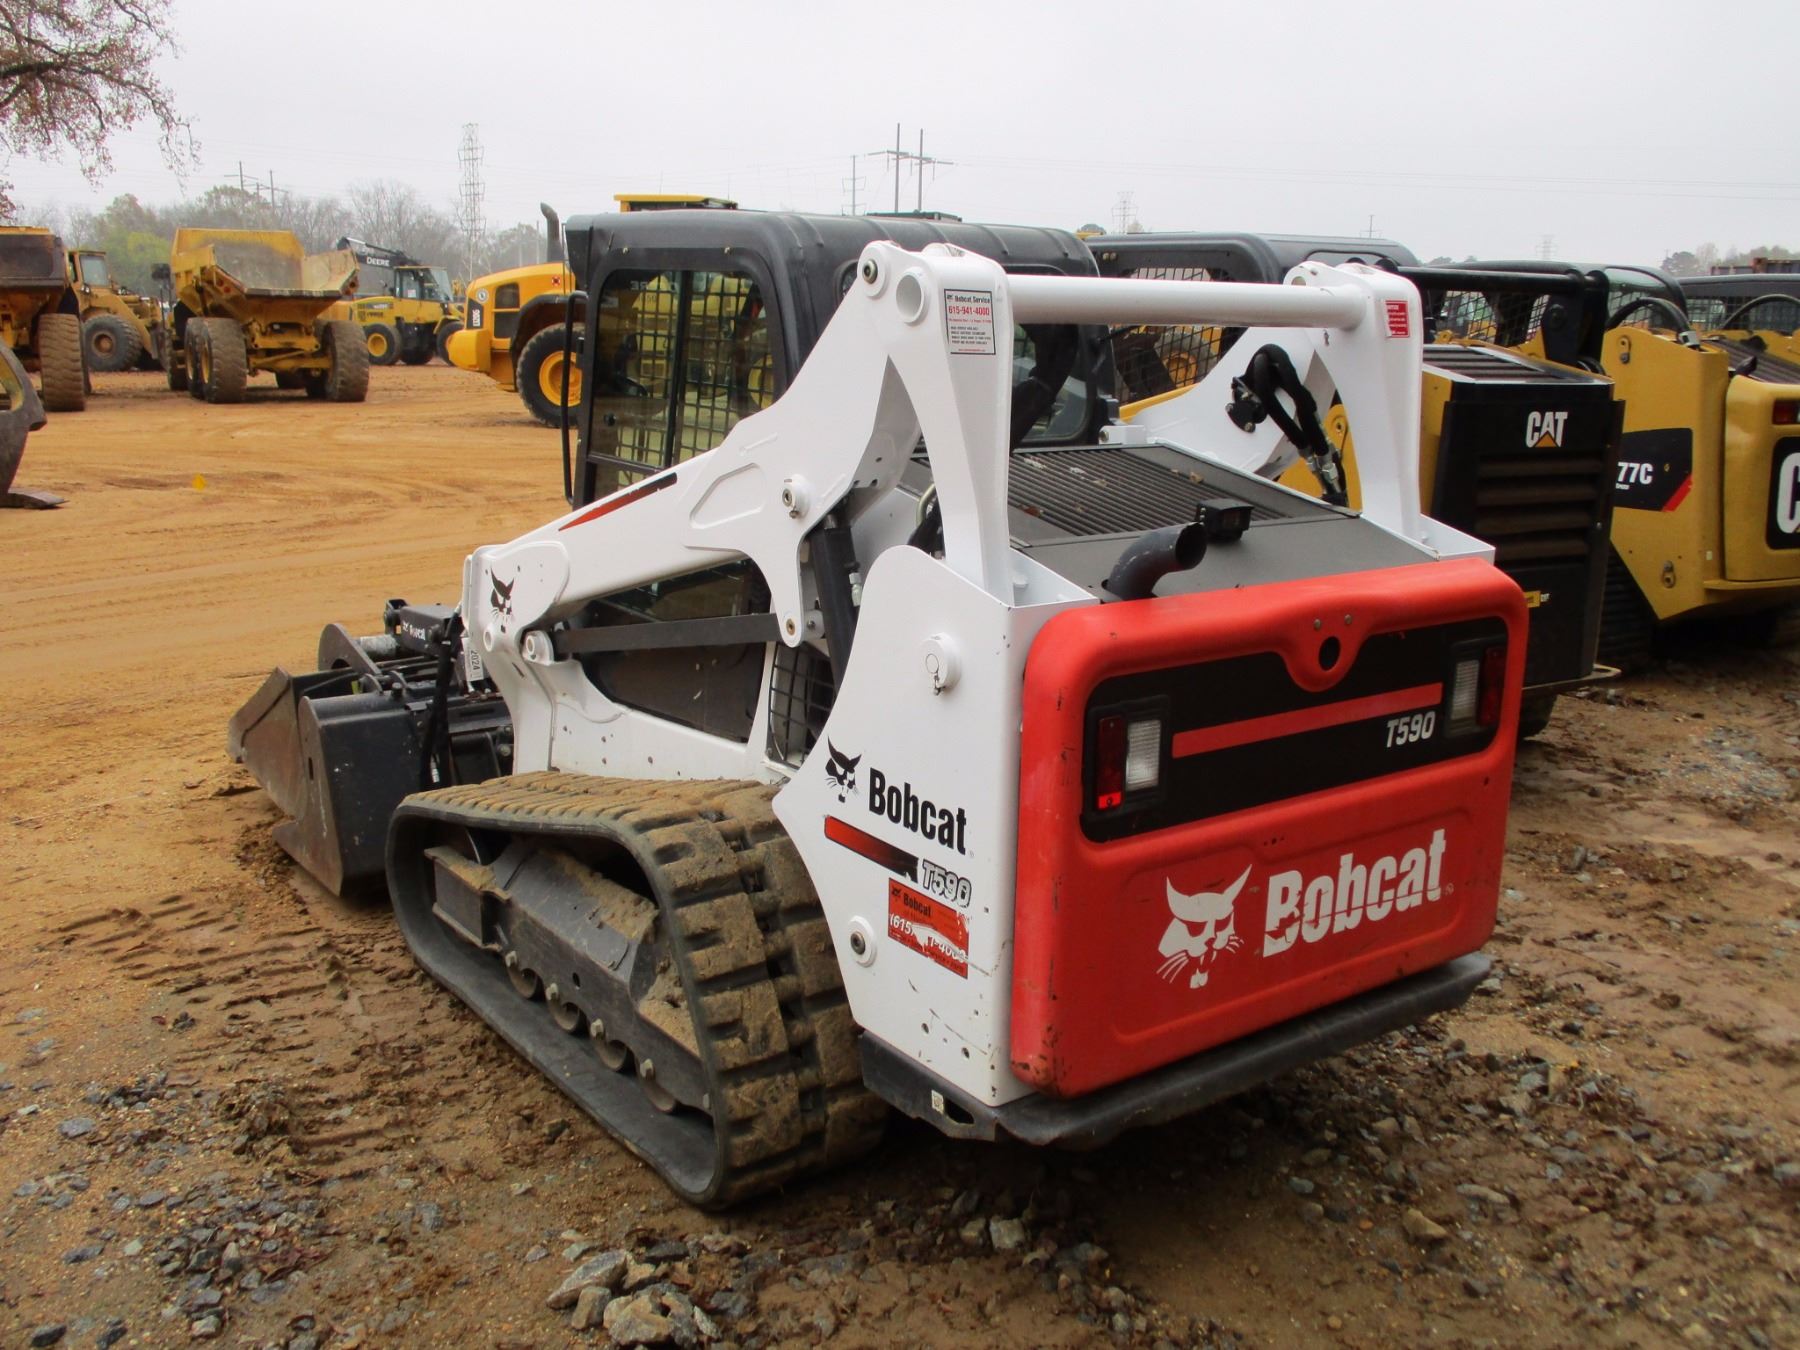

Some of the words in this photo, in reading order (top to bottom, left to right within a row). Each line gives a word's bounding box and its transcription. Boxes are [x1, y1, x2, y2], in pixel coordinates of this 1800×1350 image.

[366, 256, 390, 267] DEERE
[948, 306, 990, 316] 615-941-4000
[954, 295, 972, 303] Bobcat
[1525, 411, 1568, 448] CAT
[1386, 711, 1436, 748] T590
[868, 767, 967, 856] Bobcat
[922, 858, 972, 908] T590
[1263, 828, 1446, 958] Bobcat
[903, 893, 932, 917] Bobcat
